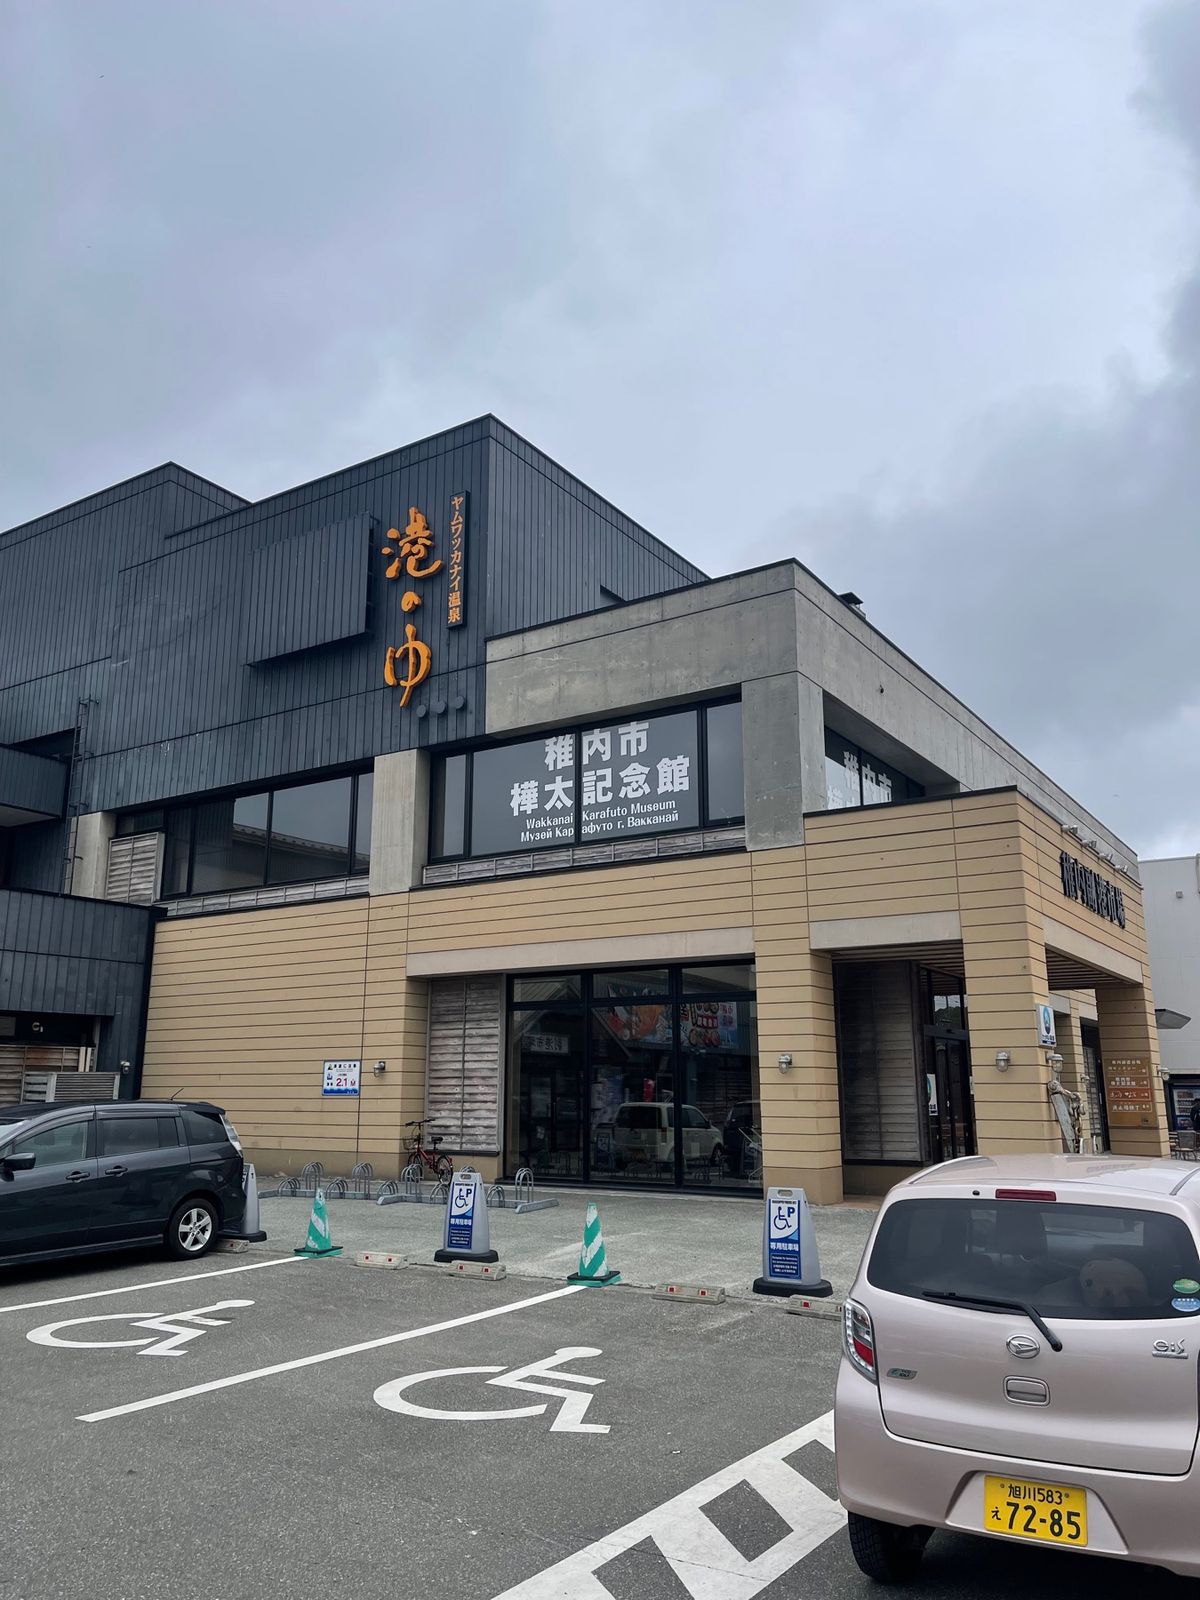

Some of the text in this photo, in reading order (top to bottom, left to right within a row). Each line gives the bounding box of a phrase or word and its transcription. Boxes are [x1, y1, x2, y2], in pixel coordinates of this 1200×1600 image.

[447, 495, 465, 624] ヤムワッカナイ温泉
[544, 721, 649, 771] 稚内市
[509, 755, 690, 816] 樺太記念館
[521, 829, 553, 842] Музей
[628, 811, 679, 828] Вакканай
[526, 800, 676, 829] Wakkanai Karafuto Museum
[466, 1188, 473, 1198] P
[787, 1206, 796, 1218] P
[1007, 1483, 1064, 1506] 旭川583
[991, 1501, 1081, 1540] え 72-85
